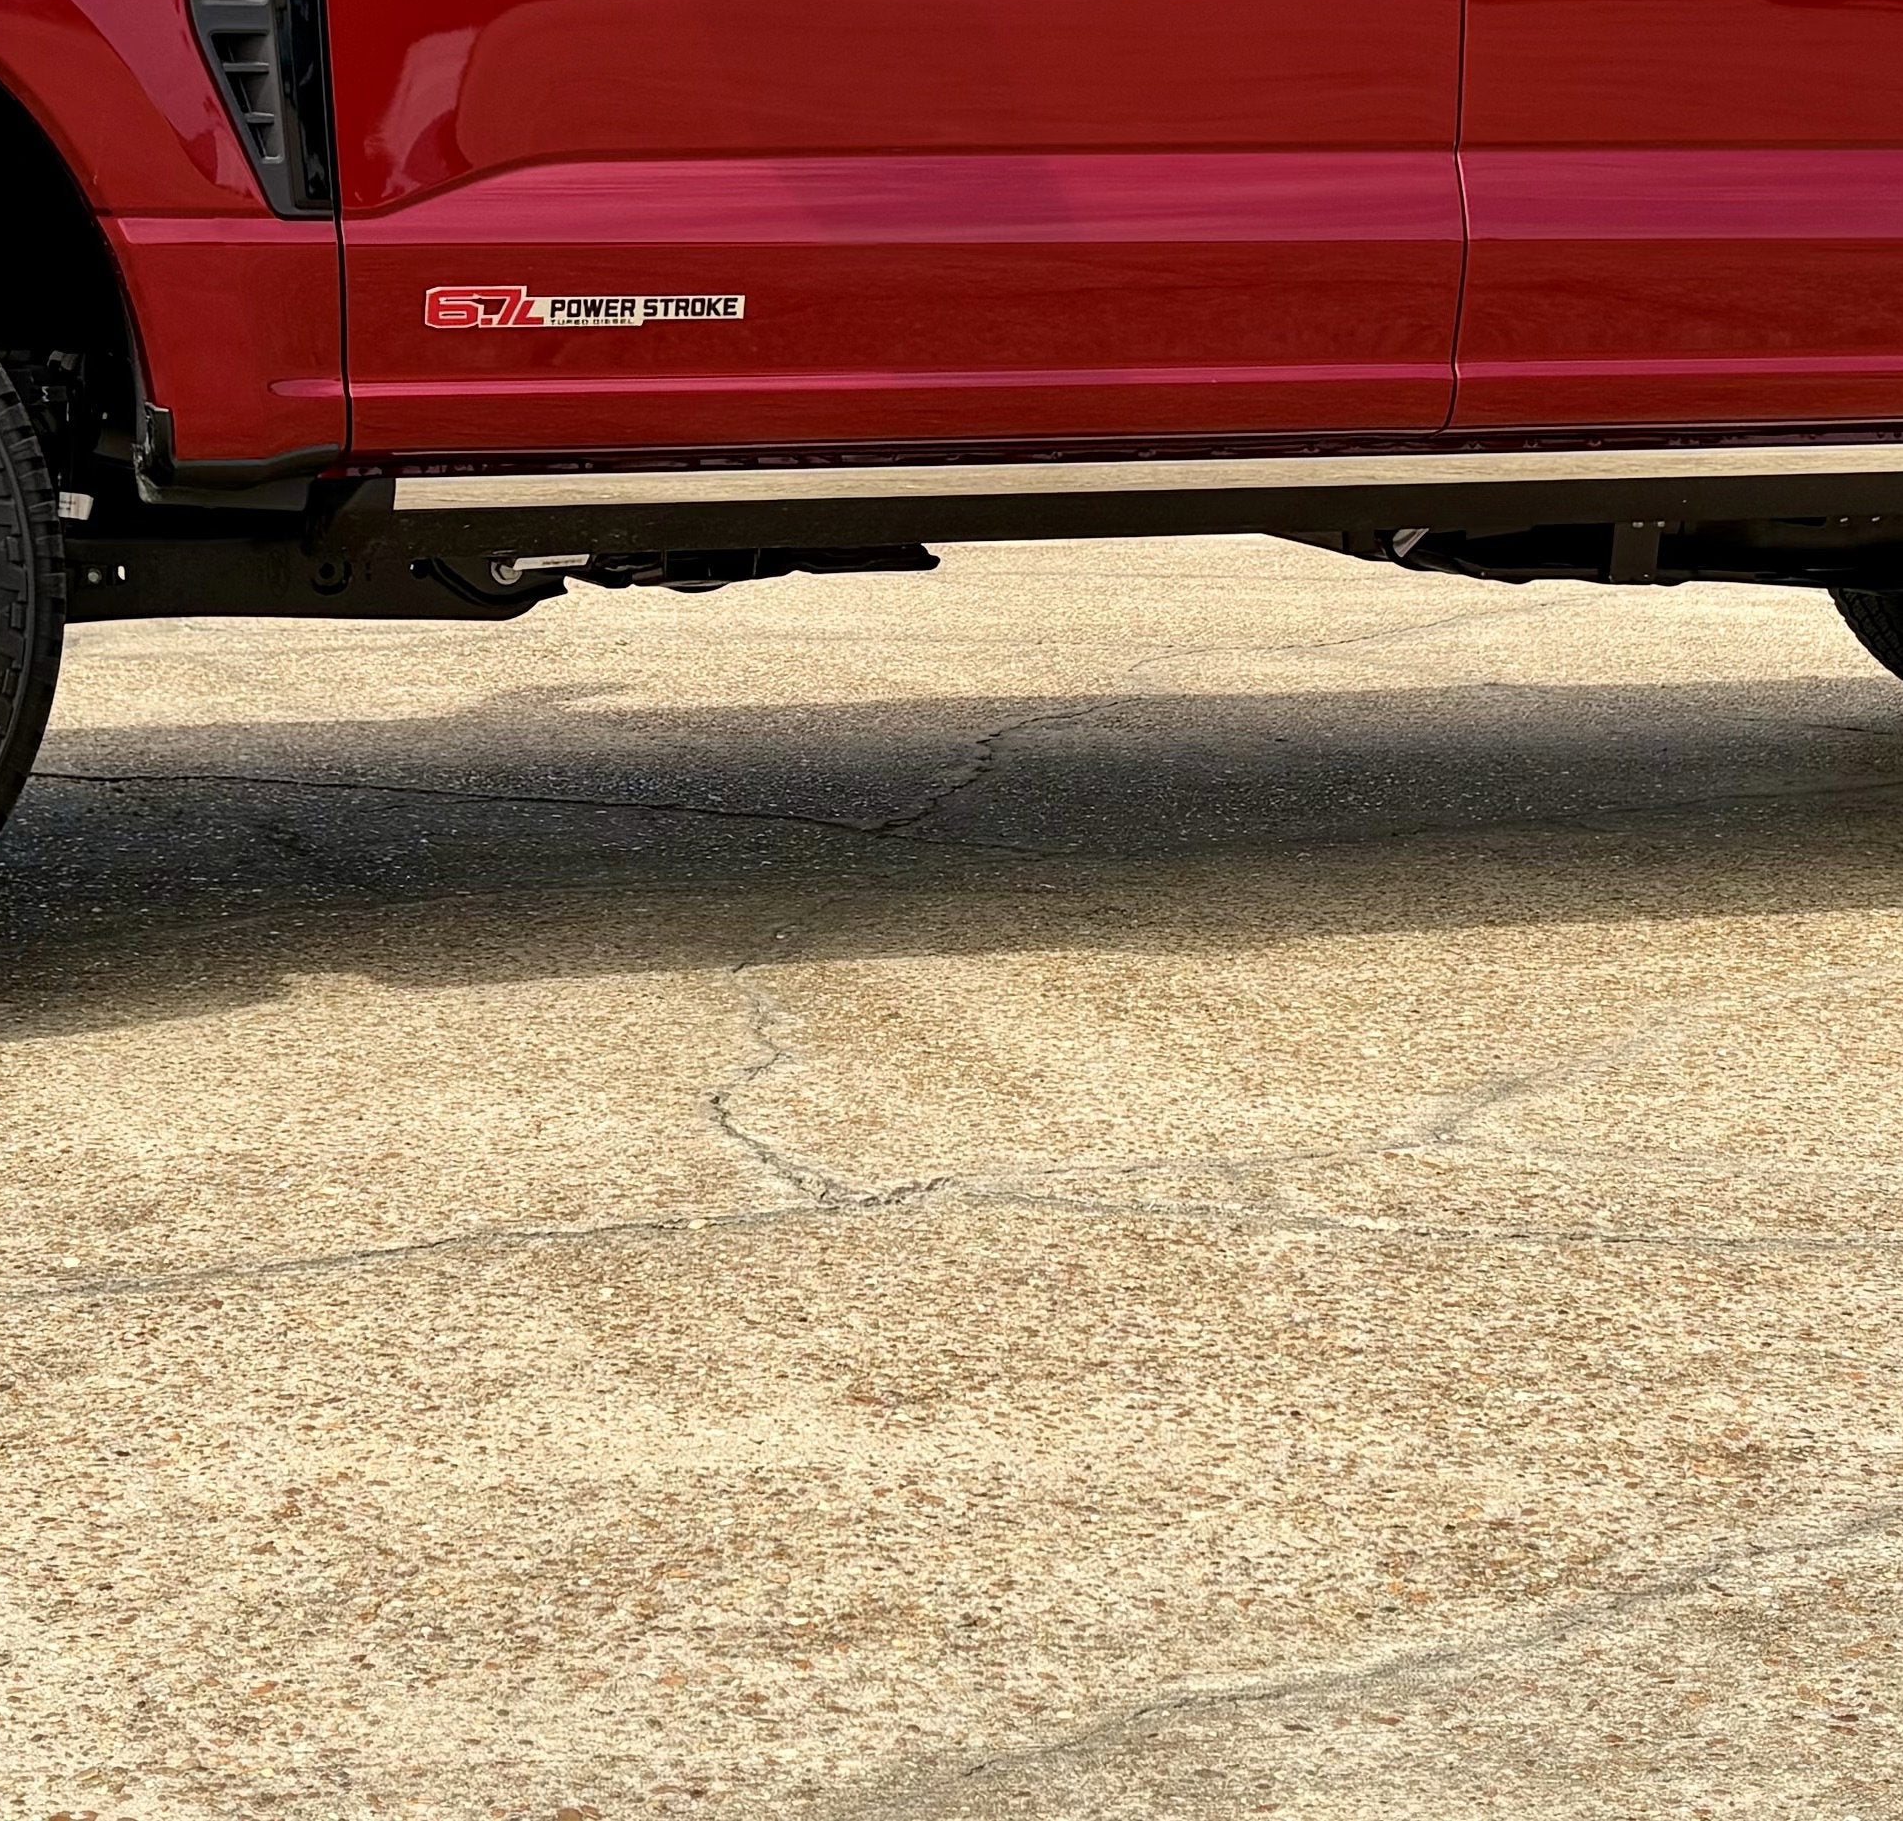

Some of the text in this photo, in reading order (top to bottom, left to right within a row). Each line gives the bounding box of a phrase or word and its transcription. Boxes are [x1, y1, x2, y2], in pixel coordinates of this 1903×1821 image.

[426, 286, 739, 328] 6.7L POWER STROKE
